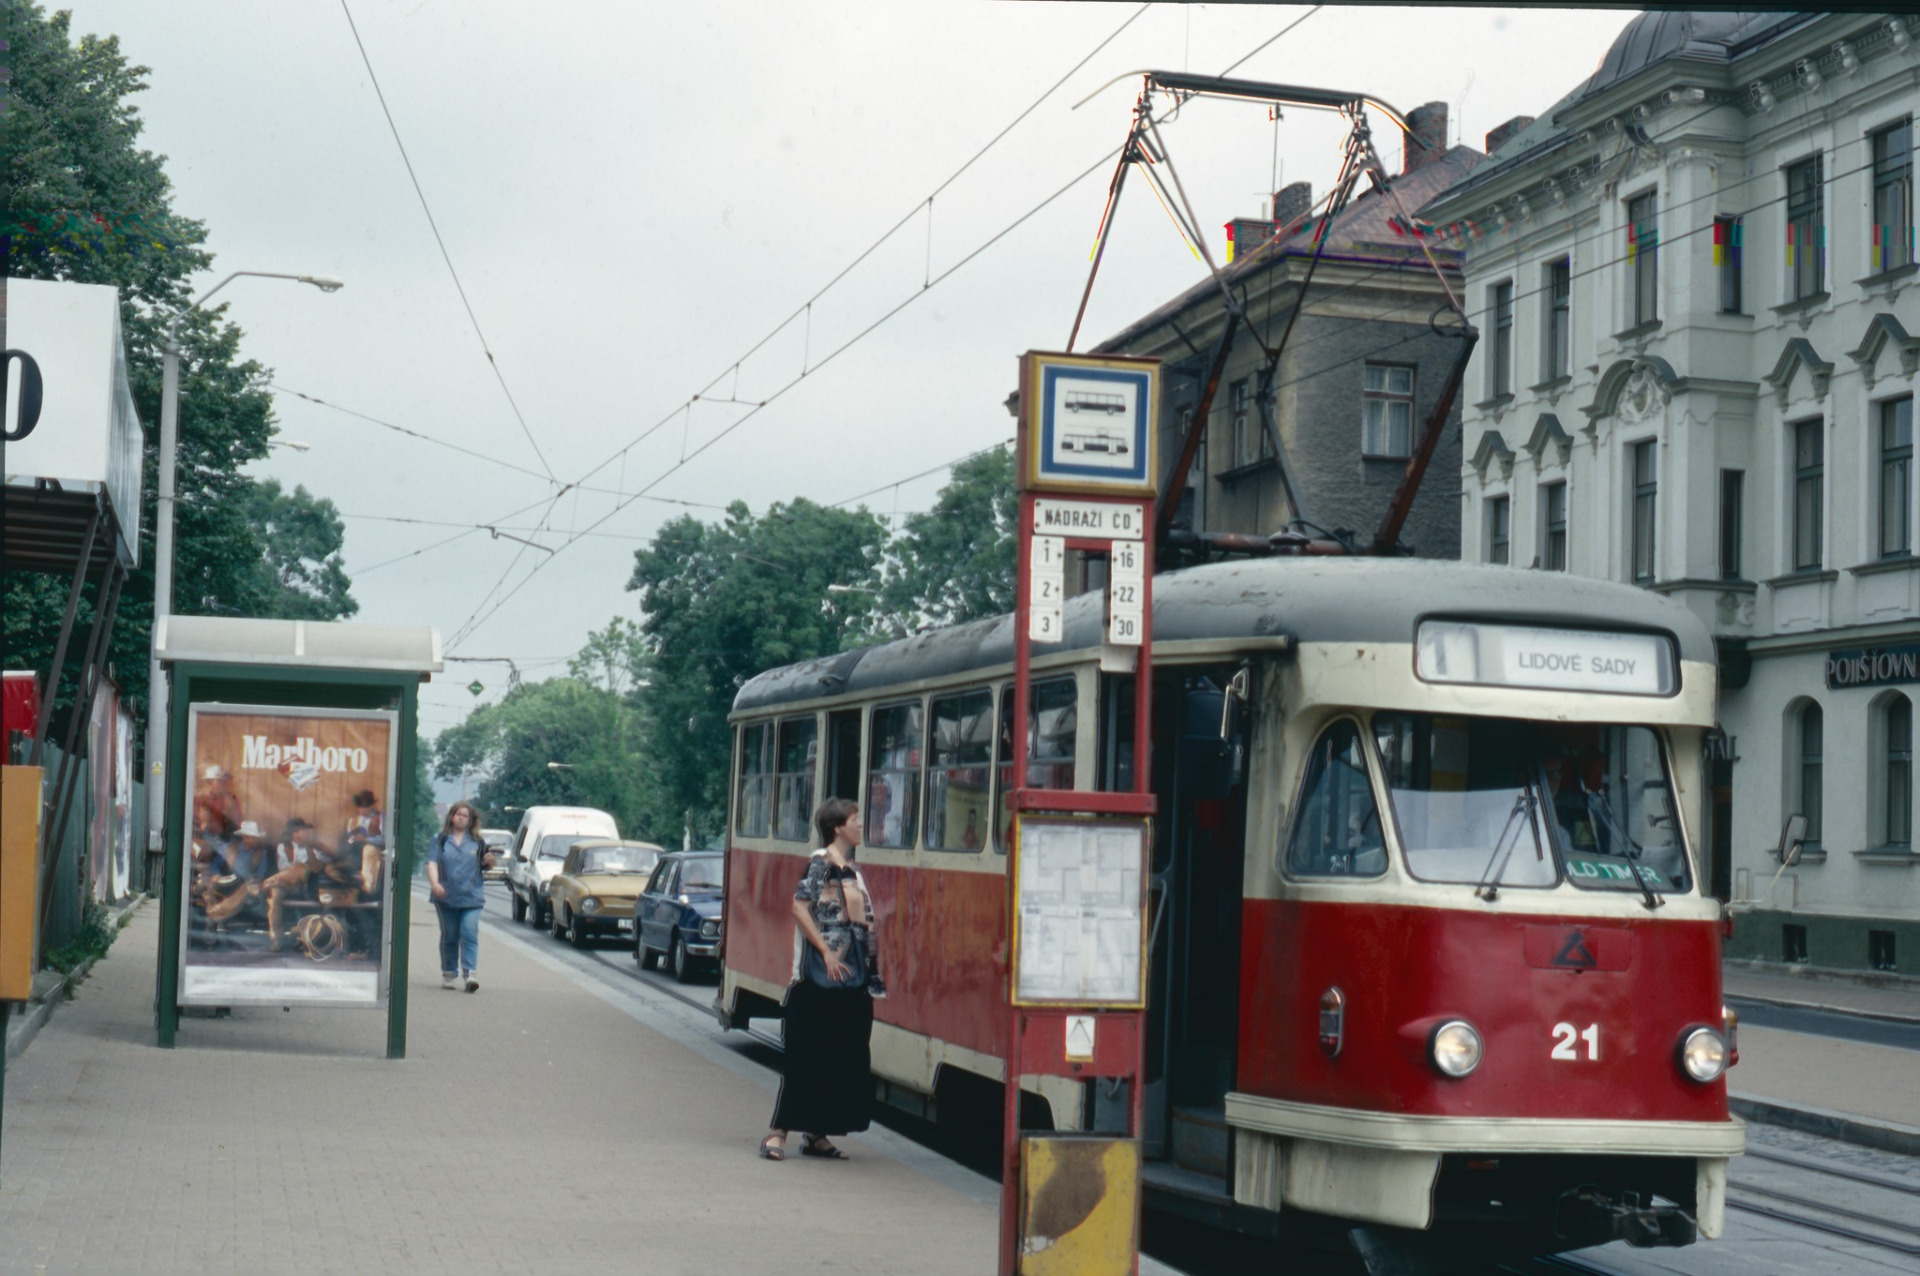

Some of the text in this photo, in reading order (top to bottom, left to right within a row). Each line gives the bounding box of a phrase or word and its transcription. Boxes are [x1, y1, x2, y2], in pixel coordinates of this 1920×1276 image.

[1112, 510, 1131, 530] ČD
[1044, 547, 1050, 563] 1
[1120, 552, 1134, 568] 16
[1043, 581, 1050, 597] 2
[1119, 587, 1134, 603] 22
[1042, 617, 1050, 632] 3
[1118, 620, 1134, 635] 30
[1519, 652, 1636, 676] LIDOVÉ SADY
[241, 735, 368, 773] Marlboro
[1551, 1022, 1598, 1060] 21
